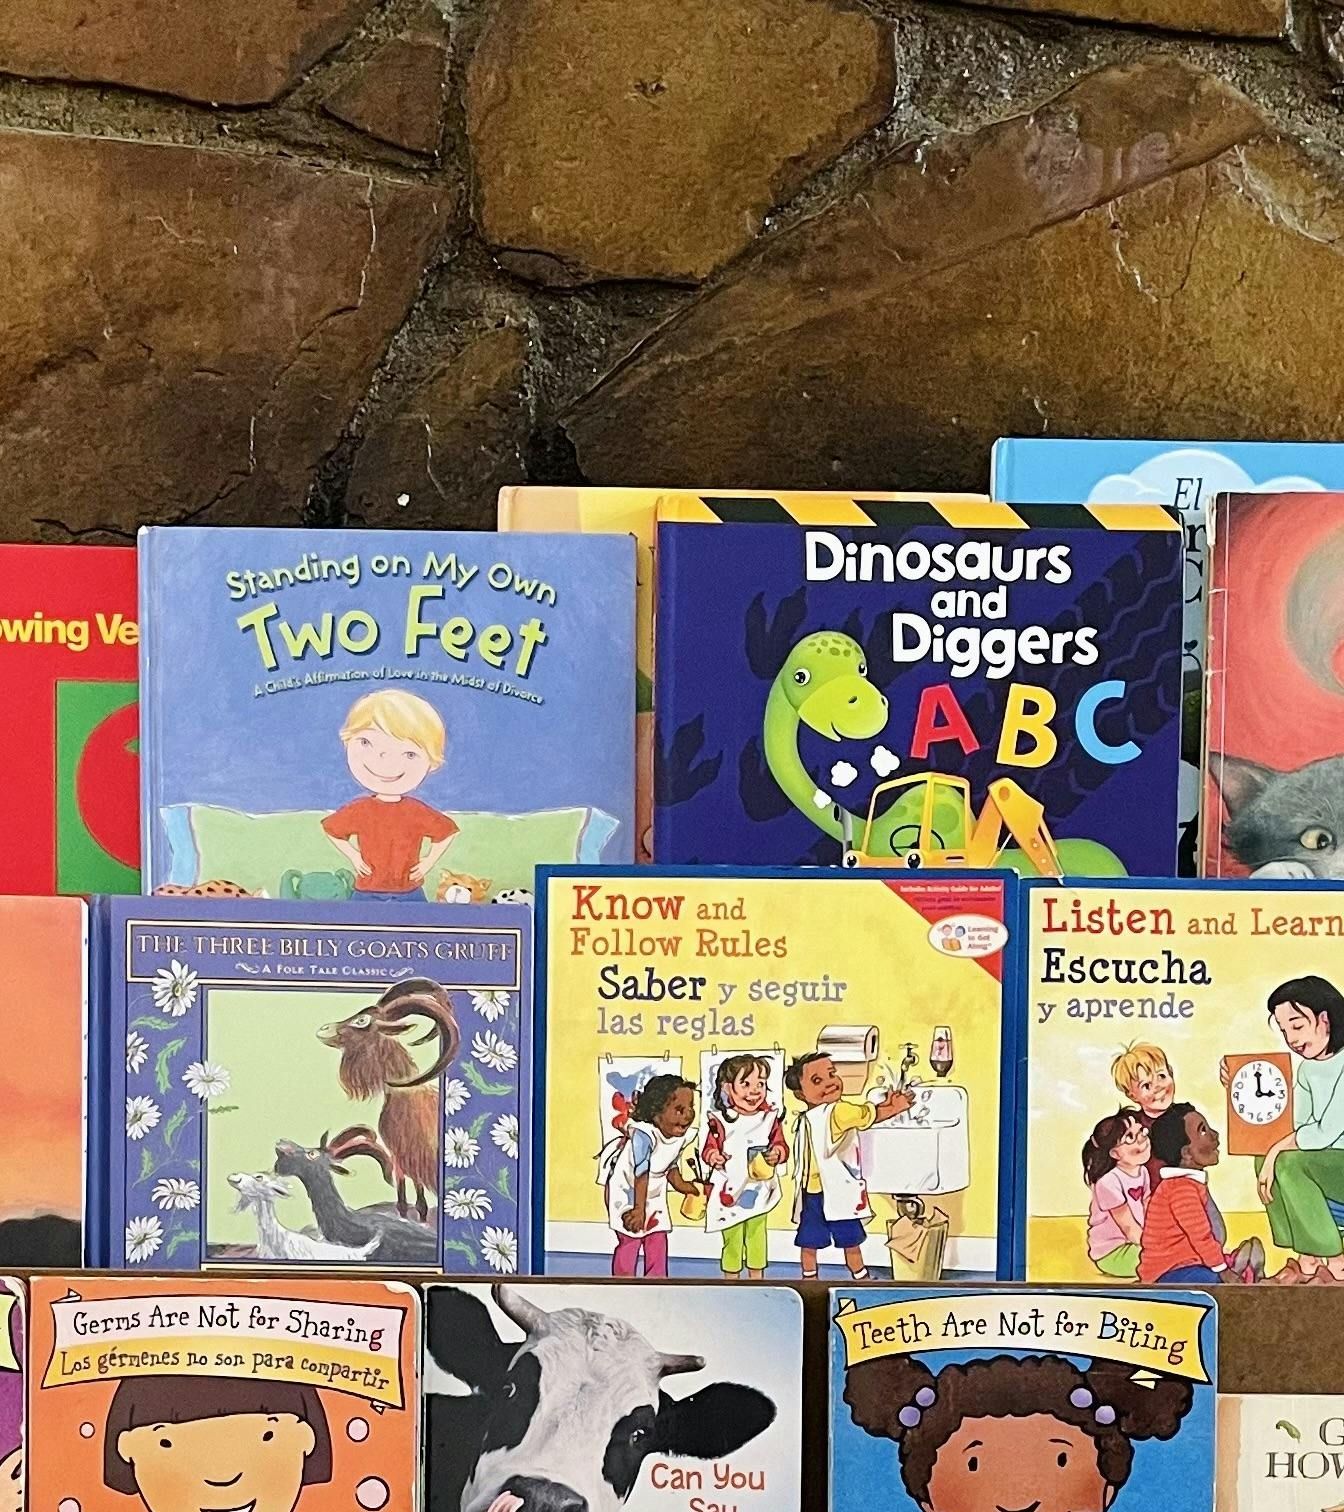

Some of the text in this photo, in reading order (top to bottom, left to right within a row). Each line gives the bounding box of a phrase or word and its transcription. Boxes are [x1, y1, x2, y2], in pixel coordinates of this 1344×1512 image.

[1174, 477, 1202, 510] El
[805, 531, 1072, 583] Dinosaurs
[226, 552, 556, 605] Standing on My Own
[931, 585, 1007, 619] and
[236, 584, 547, 679] Two Feet
[892, 613, 1099, 679] Diggers
[571, 884, 746, 921] Know and
[1041, 898, 1176, 935] Listen
[1187, 914, 1238, 936] and
[137, 934, 513, 963] THE THREE BILLY GOATS GRUFF
[570, 928, 788, 958] Follow Rules
[1040, 947, 1212, 986] Escucha
[597, 965, 847, 1007] Saber y seguir
[596, 1007, 755, 1041] las reglas
[1038, 993, 1195, 1023] y aprende
[651, 1463, 764, 1491] Can You
